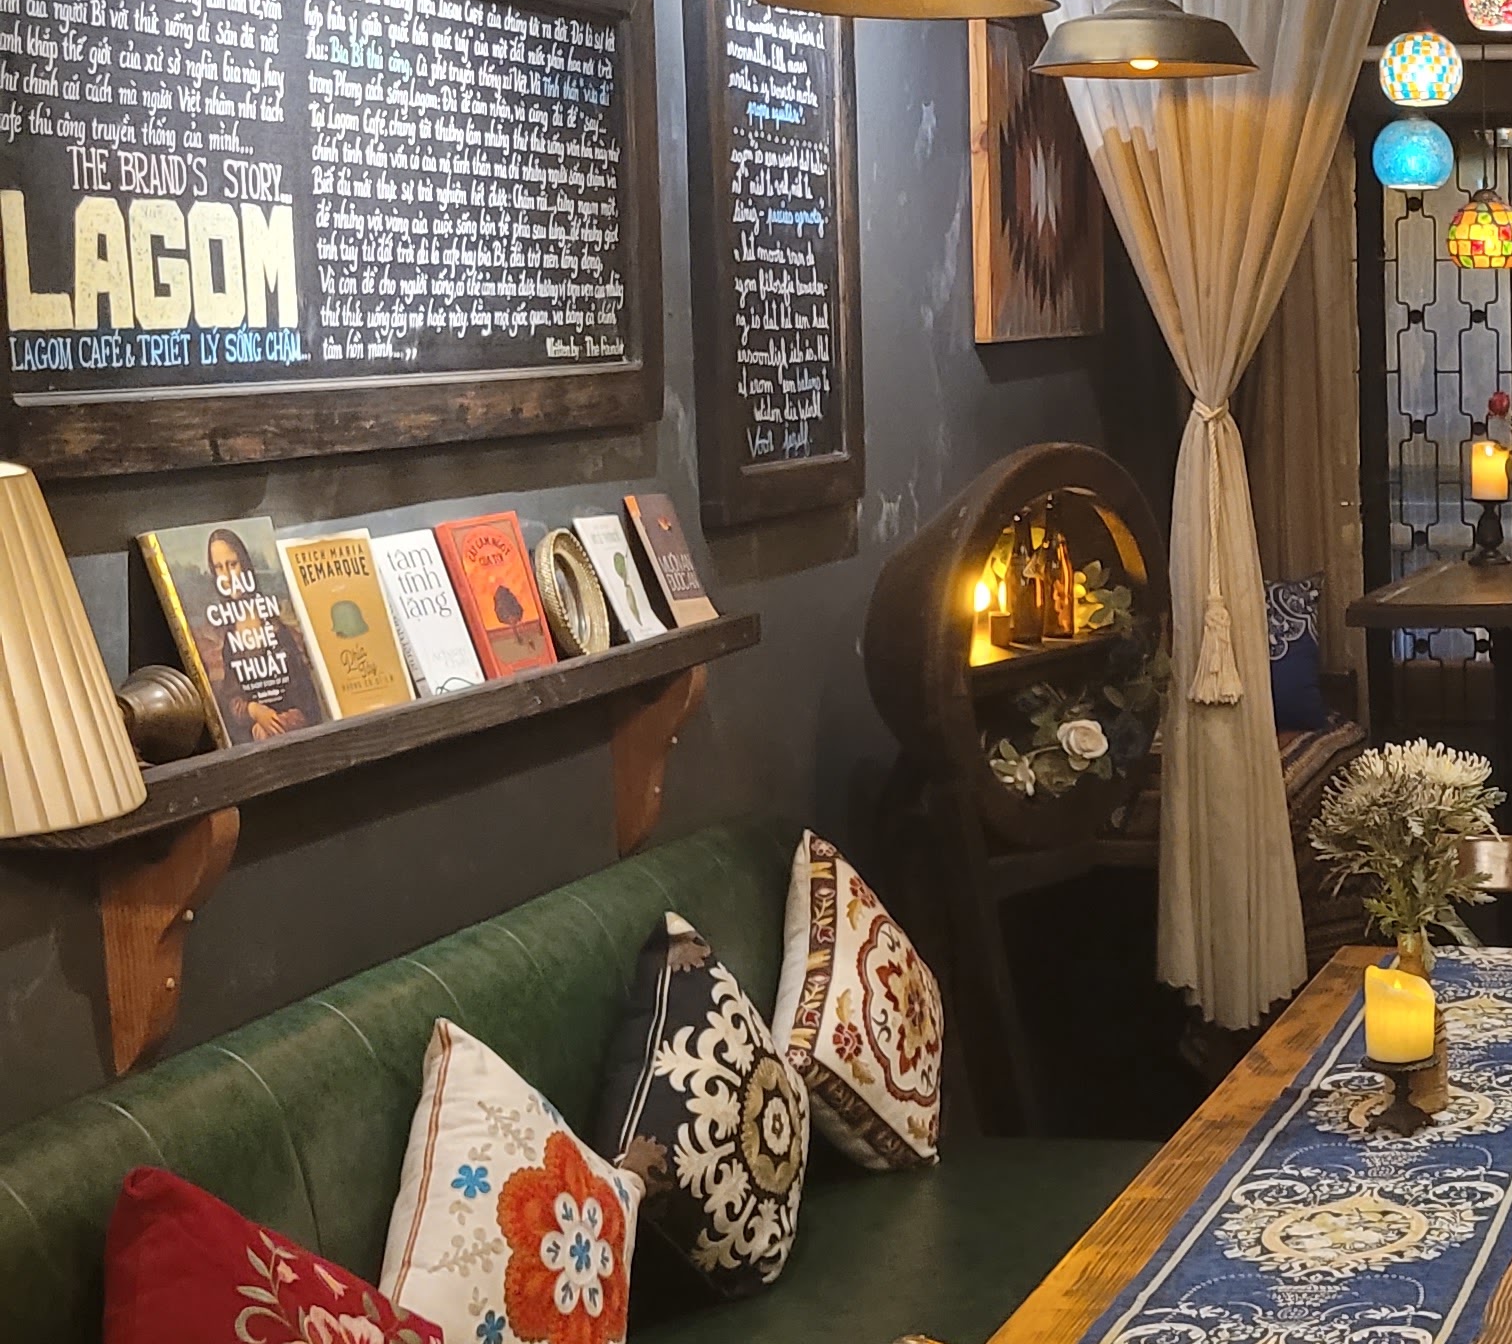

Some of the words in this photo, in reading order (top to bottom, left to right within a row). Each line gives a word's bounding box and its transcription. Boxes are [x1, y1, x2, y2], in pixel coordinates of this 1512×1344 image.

[109, 0, 129, 30] với
[134, 1, 160, 35] thức
[164, 12, 194, 49] uống
[197, 11, 210, 43] di
[26, 24, 58, 72] khắp
[62, 29, 88, 62] thế
[88, 36, 113, 75] giới
[119, 39, 142, 70] của
[144, 46, 164, 72] xứ
[167, 47, 182, 76] sở
[222, 50, 242, 83] bia
[264, 57, 285, 99] hay
[23, 63, 59, 97] chính
[62, 73, 81, 101] cái
[85, 72, 113, 103] cách
[118, 79, 138, 106] mà
[176, 85, 202, 118] Việt
[28, 102, 54, 136] thủ
[56, 111, 86, 146] công
[92, 113, 137, 150] truyền
[141, 116, 176, 154] thống
[327, 103, 360, 141] Lagom
[66, 145, 112, 191] THE
[117, 150, 208, 196] BRAND'S
[1, 189, 299, 331] LAGOM
[318, 265, 336, 294] Và
[338, 267, 357, 295] còn
[379, 263, 397, 296] cho
[9, 336, 73, 371] LAGOM
[78, 329, 120, 369] CAFÉ
[125, 350, 136, 367] &
[137, 329, 191, 366] TRIẾT
[200, 328, 220, 364] LÝ
[225, 324, 263, 362] SỐNG
[322, 335, 343, 360] tâm
[294, 550, 325, 565] ERICH
[330, 544, 364, 558] MARIA
[387, 547, 434, 572] tâm
[298, 557, 371, 587] REMARQUE
[398, 567, 442, 595] tĩnh
[207, 593, 280, 626] CHUYỆN
[399, 591, 452, 622] lặng
[227, 620, 279, 653] NGHỆ
[230, 650, 288, 682] THUẬT
